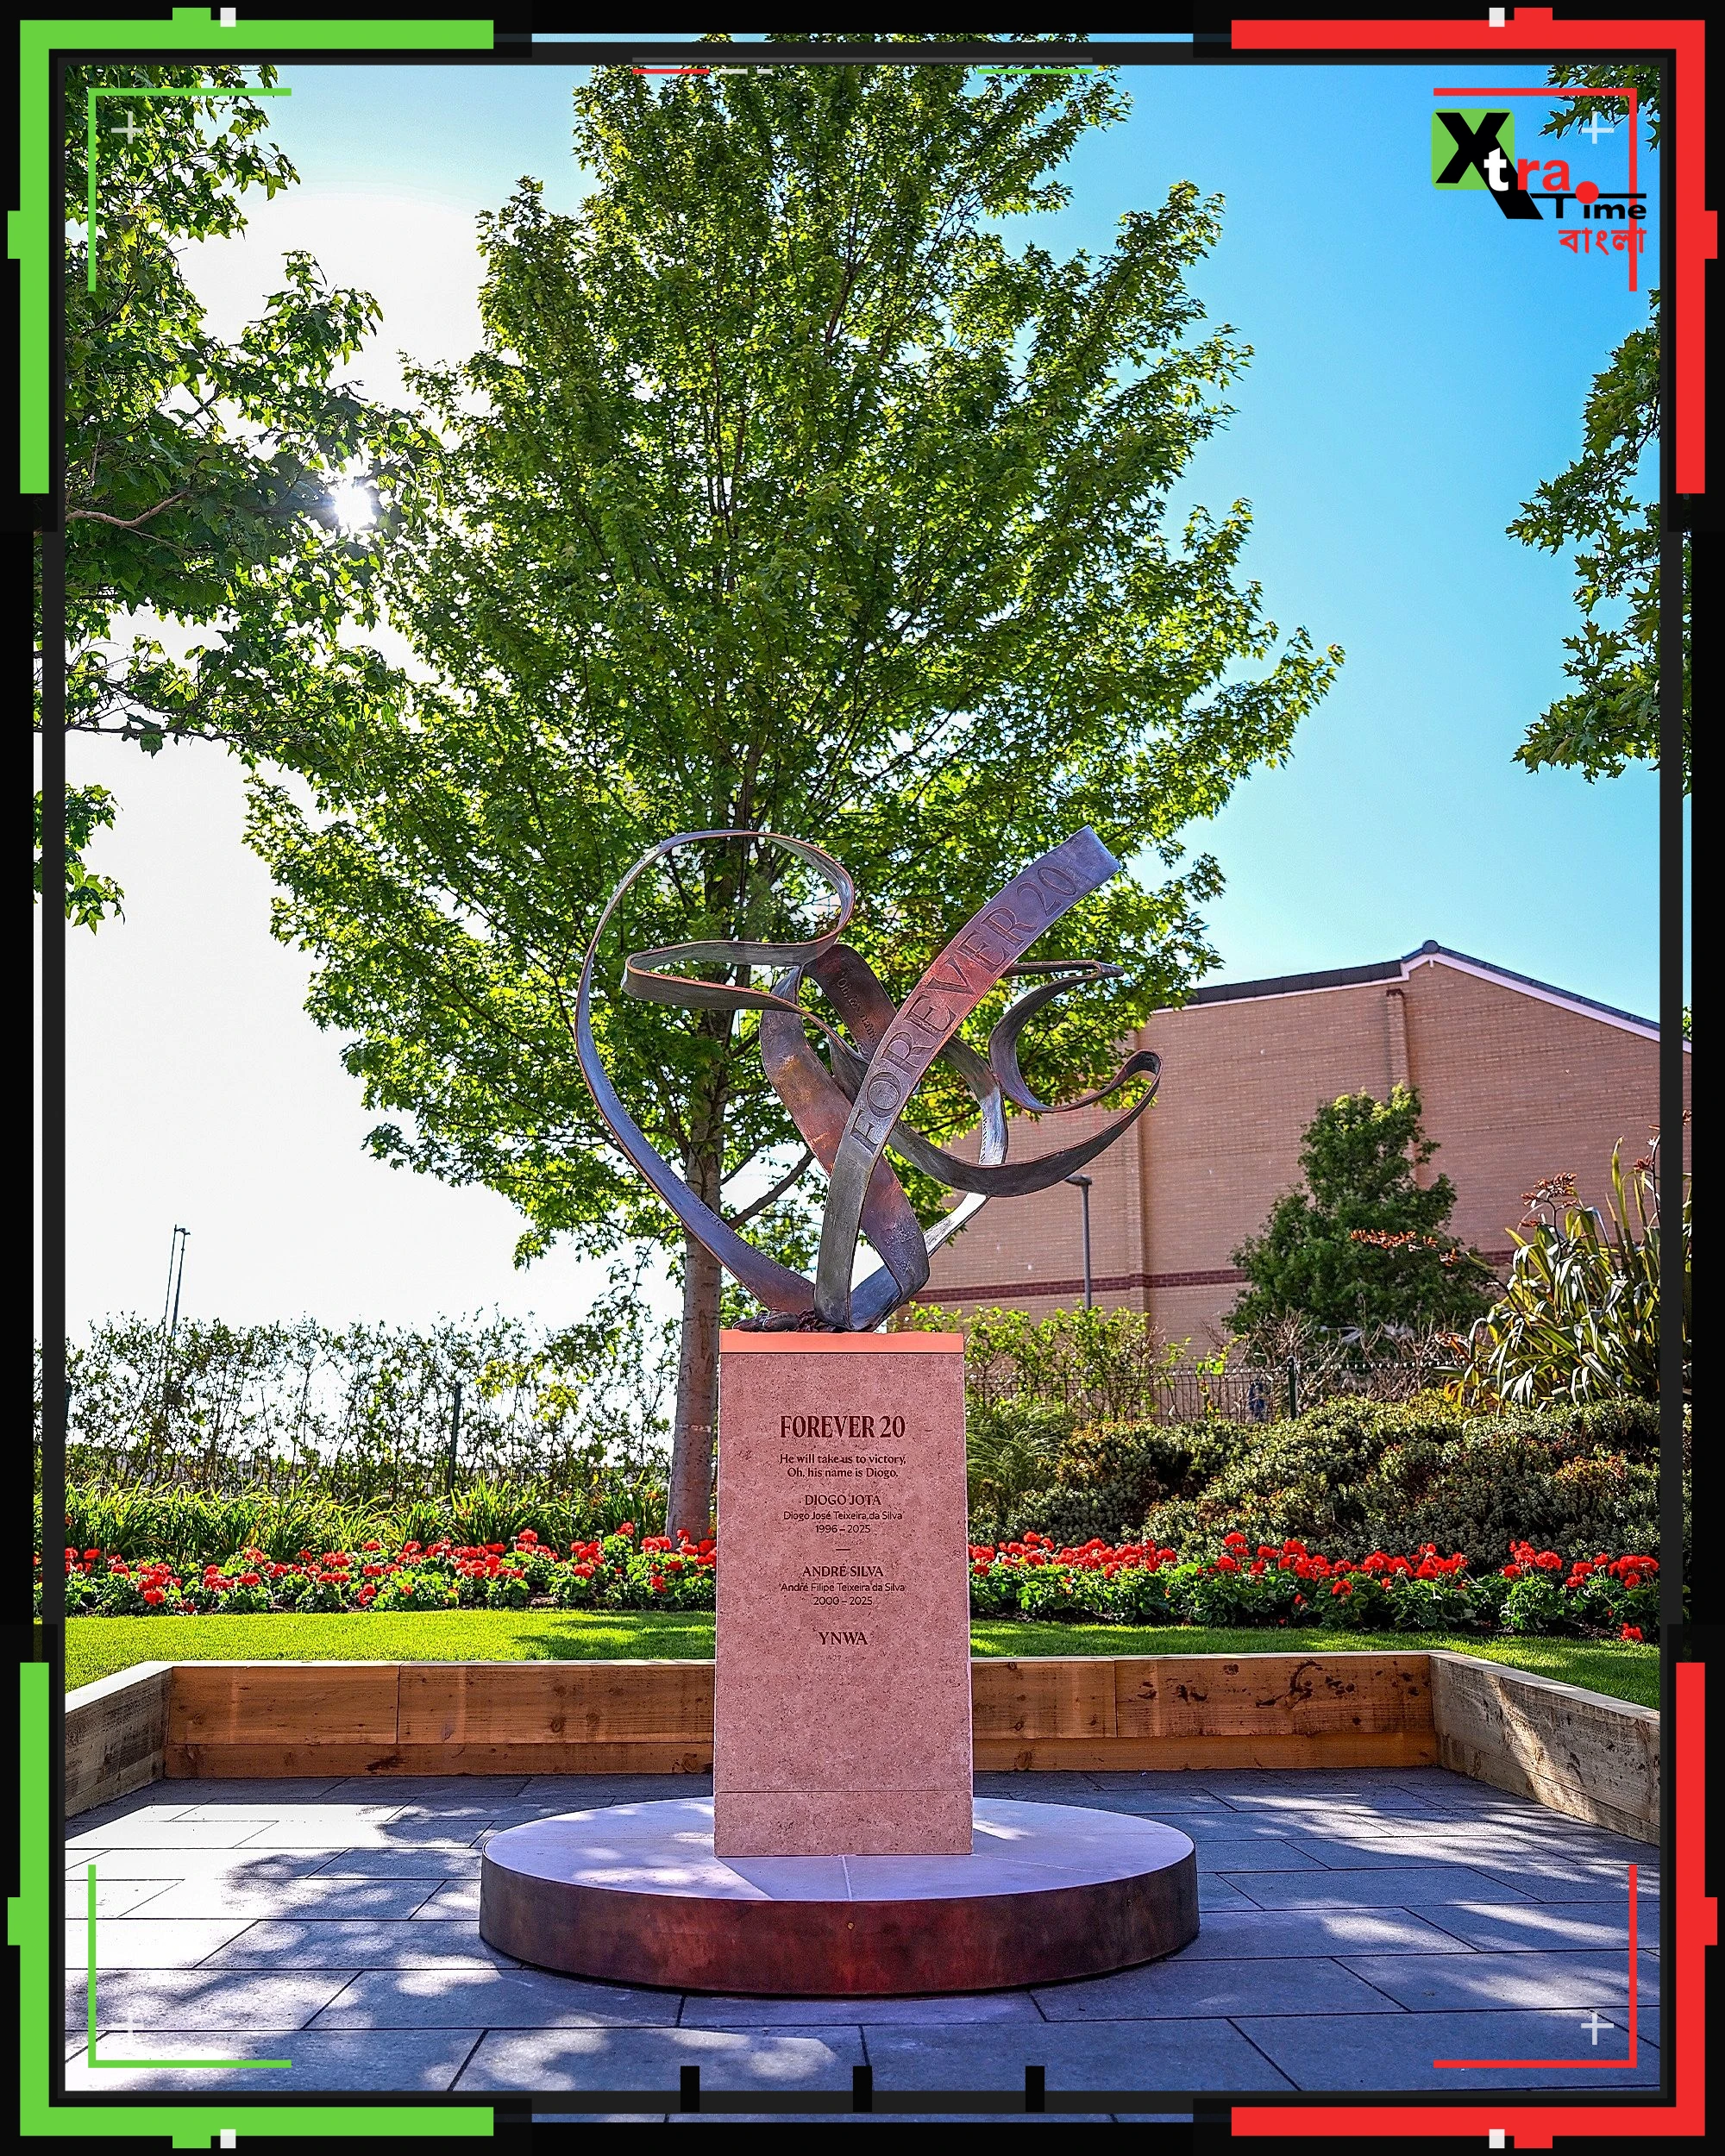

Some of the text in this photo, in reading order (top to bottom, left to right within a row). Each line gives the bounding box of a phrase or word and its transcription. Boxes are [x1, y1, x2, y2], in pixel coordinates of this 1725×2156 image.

[850, 865, 1077, 1150] FOREVER 20
[780, 1415, 906, 1438] FOREVER 20
[779, 1453, 906, 1466] He will take us to victory,
[787, 1467, 806, 1479] Oh,
[807, 1467, 823, 1477] his
[855, 1467, 863, 1477] is
[865, 1467, 899, 1480] Diogo.
[805, 1494, 882, 1506] DIOGO JOTA
[783, 1510, 903, 1522] Diogo José Teixeira da Silva
[815, 1524, 838, 1534] 1996
[847, 1524, 871, 1534] 2025
[801, 1564, 884, 1577] ANDRÉ SILVA
[780, 1583, 906, 1594] André Filipe Teixeira da Silva
[812, 1595, 840, 1606] 2000
[849, 1595, 873, 1606] 2025
[818, 1631, 869, 1645] YNWA
